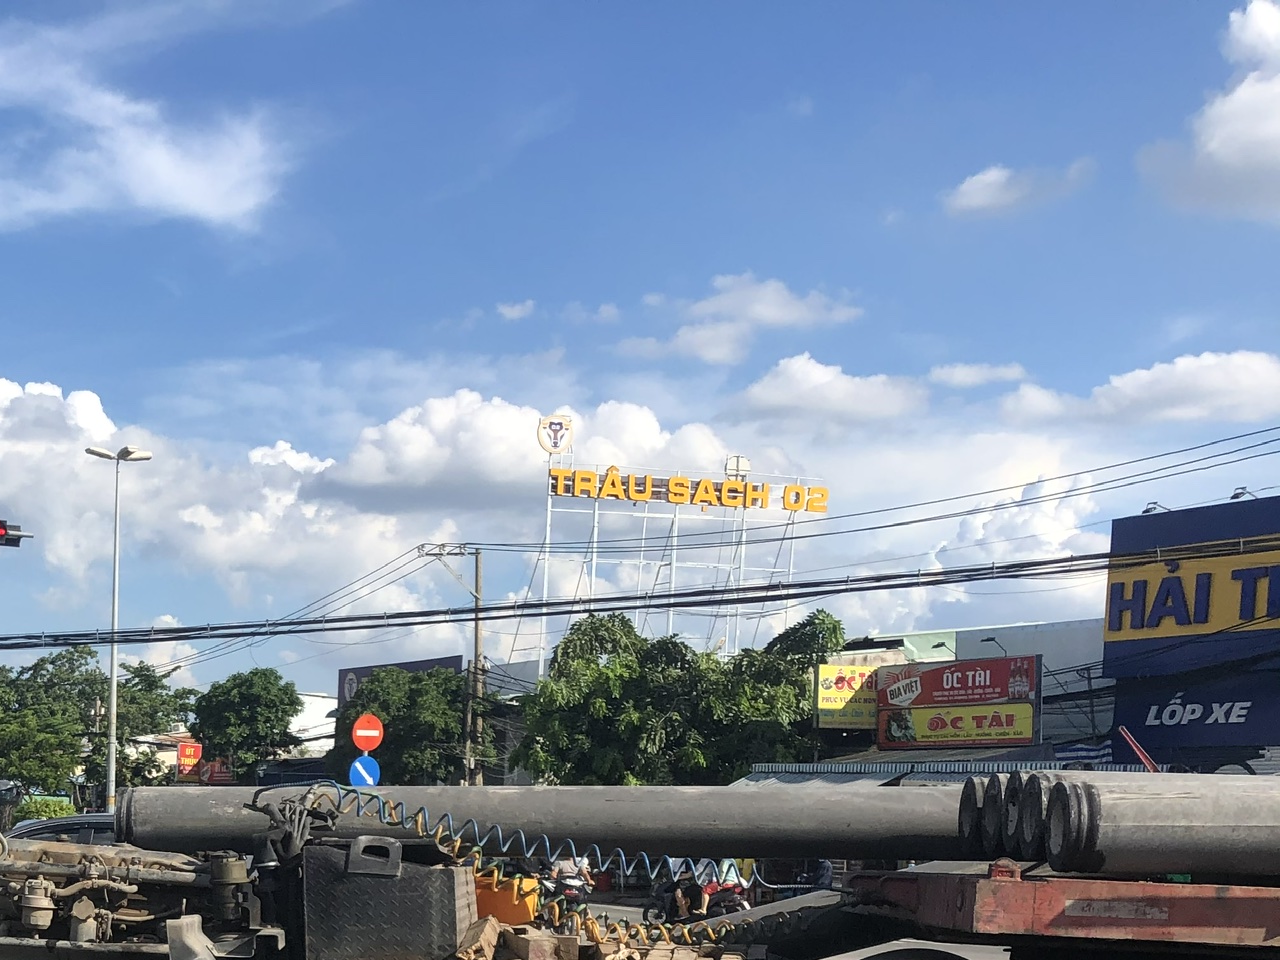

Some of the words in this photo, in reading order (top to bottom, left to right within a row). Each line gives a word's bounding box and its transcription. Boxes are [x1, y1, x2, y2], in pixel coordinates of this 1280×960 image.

[550, 465, 653, 502] TRÂU
[668, 476, 769, 512] SẠCH
[783, 485, 829, 513] 02
[1108, 560, 1212, 632] HẢI
[888, 686, 903, 700] BIA
[942, 667, 962, 689] ỐC
[966, 667, 991, 687] TÀI
[1145, 692, 1203, 726] LỐP
[1205, 701, 1252, 724] XE
